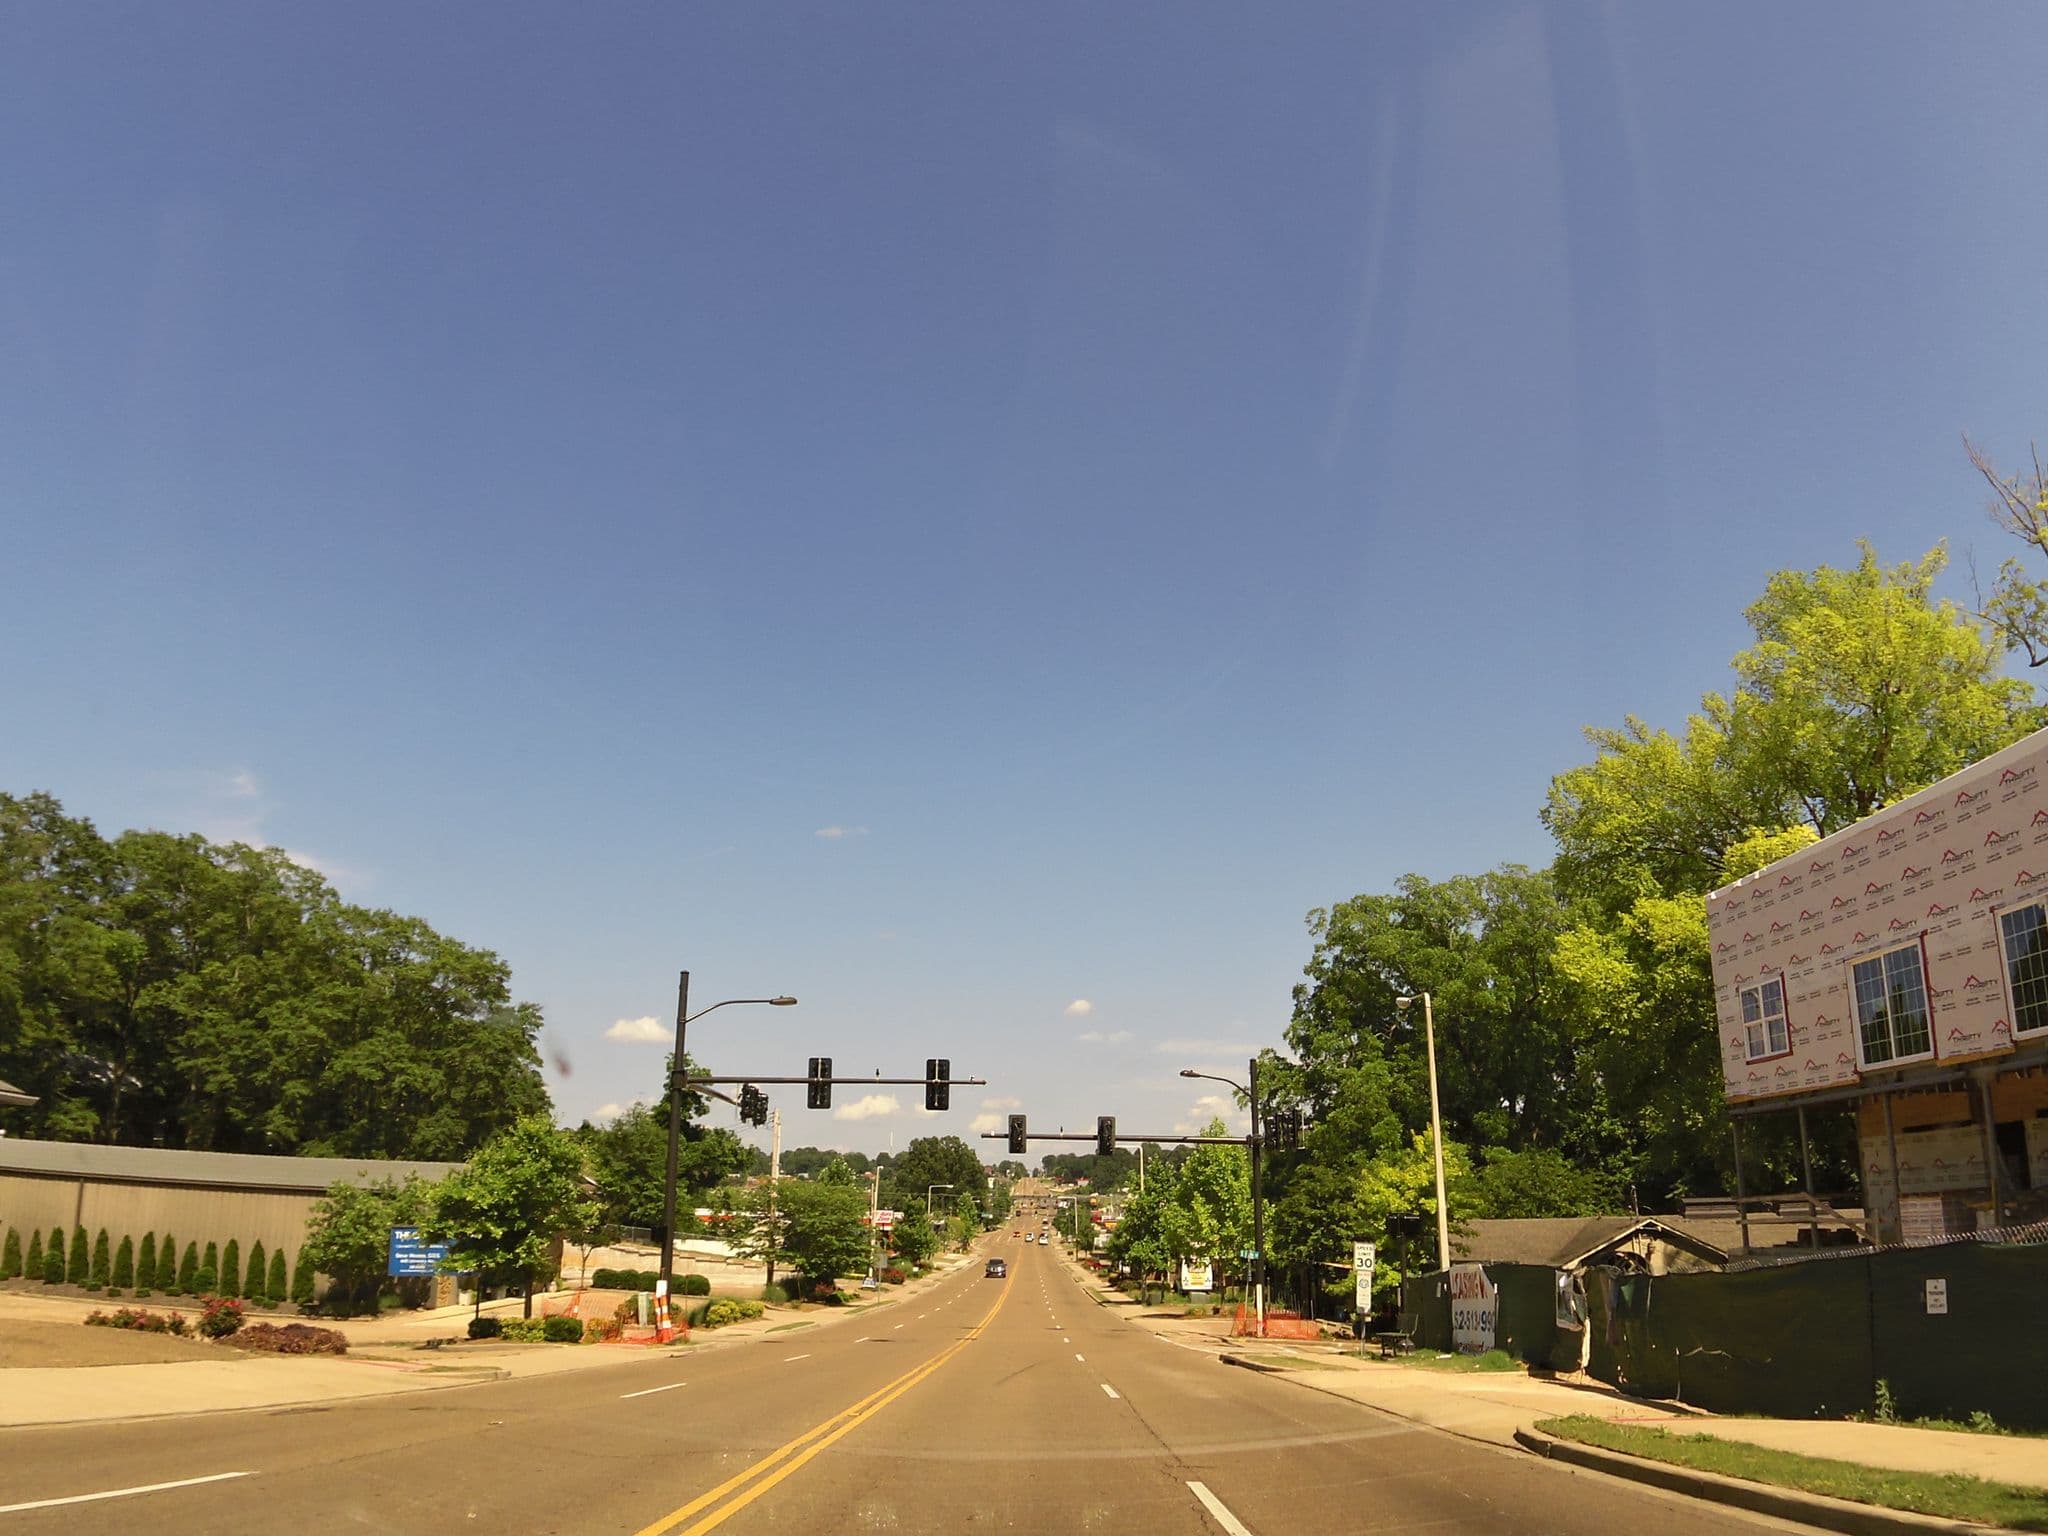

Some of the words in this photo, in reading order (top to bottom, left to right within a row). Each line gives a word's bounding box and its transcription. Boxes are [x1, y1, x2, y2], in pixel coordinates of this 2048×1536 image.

[2005, 766, 2036, 784] THRIFTY
[1989, 830, 2020, 847] THRIFTY
[1974, 888, 2004, 904] THRIFTY
[1931, 904, 1960, 919] THRIFTY
[1968, 979, 1998, 991] THRIFTY
[1953, 1032, 1982, 1043] THRIFTY
[1356, 1257, 1373, 1268] 30
